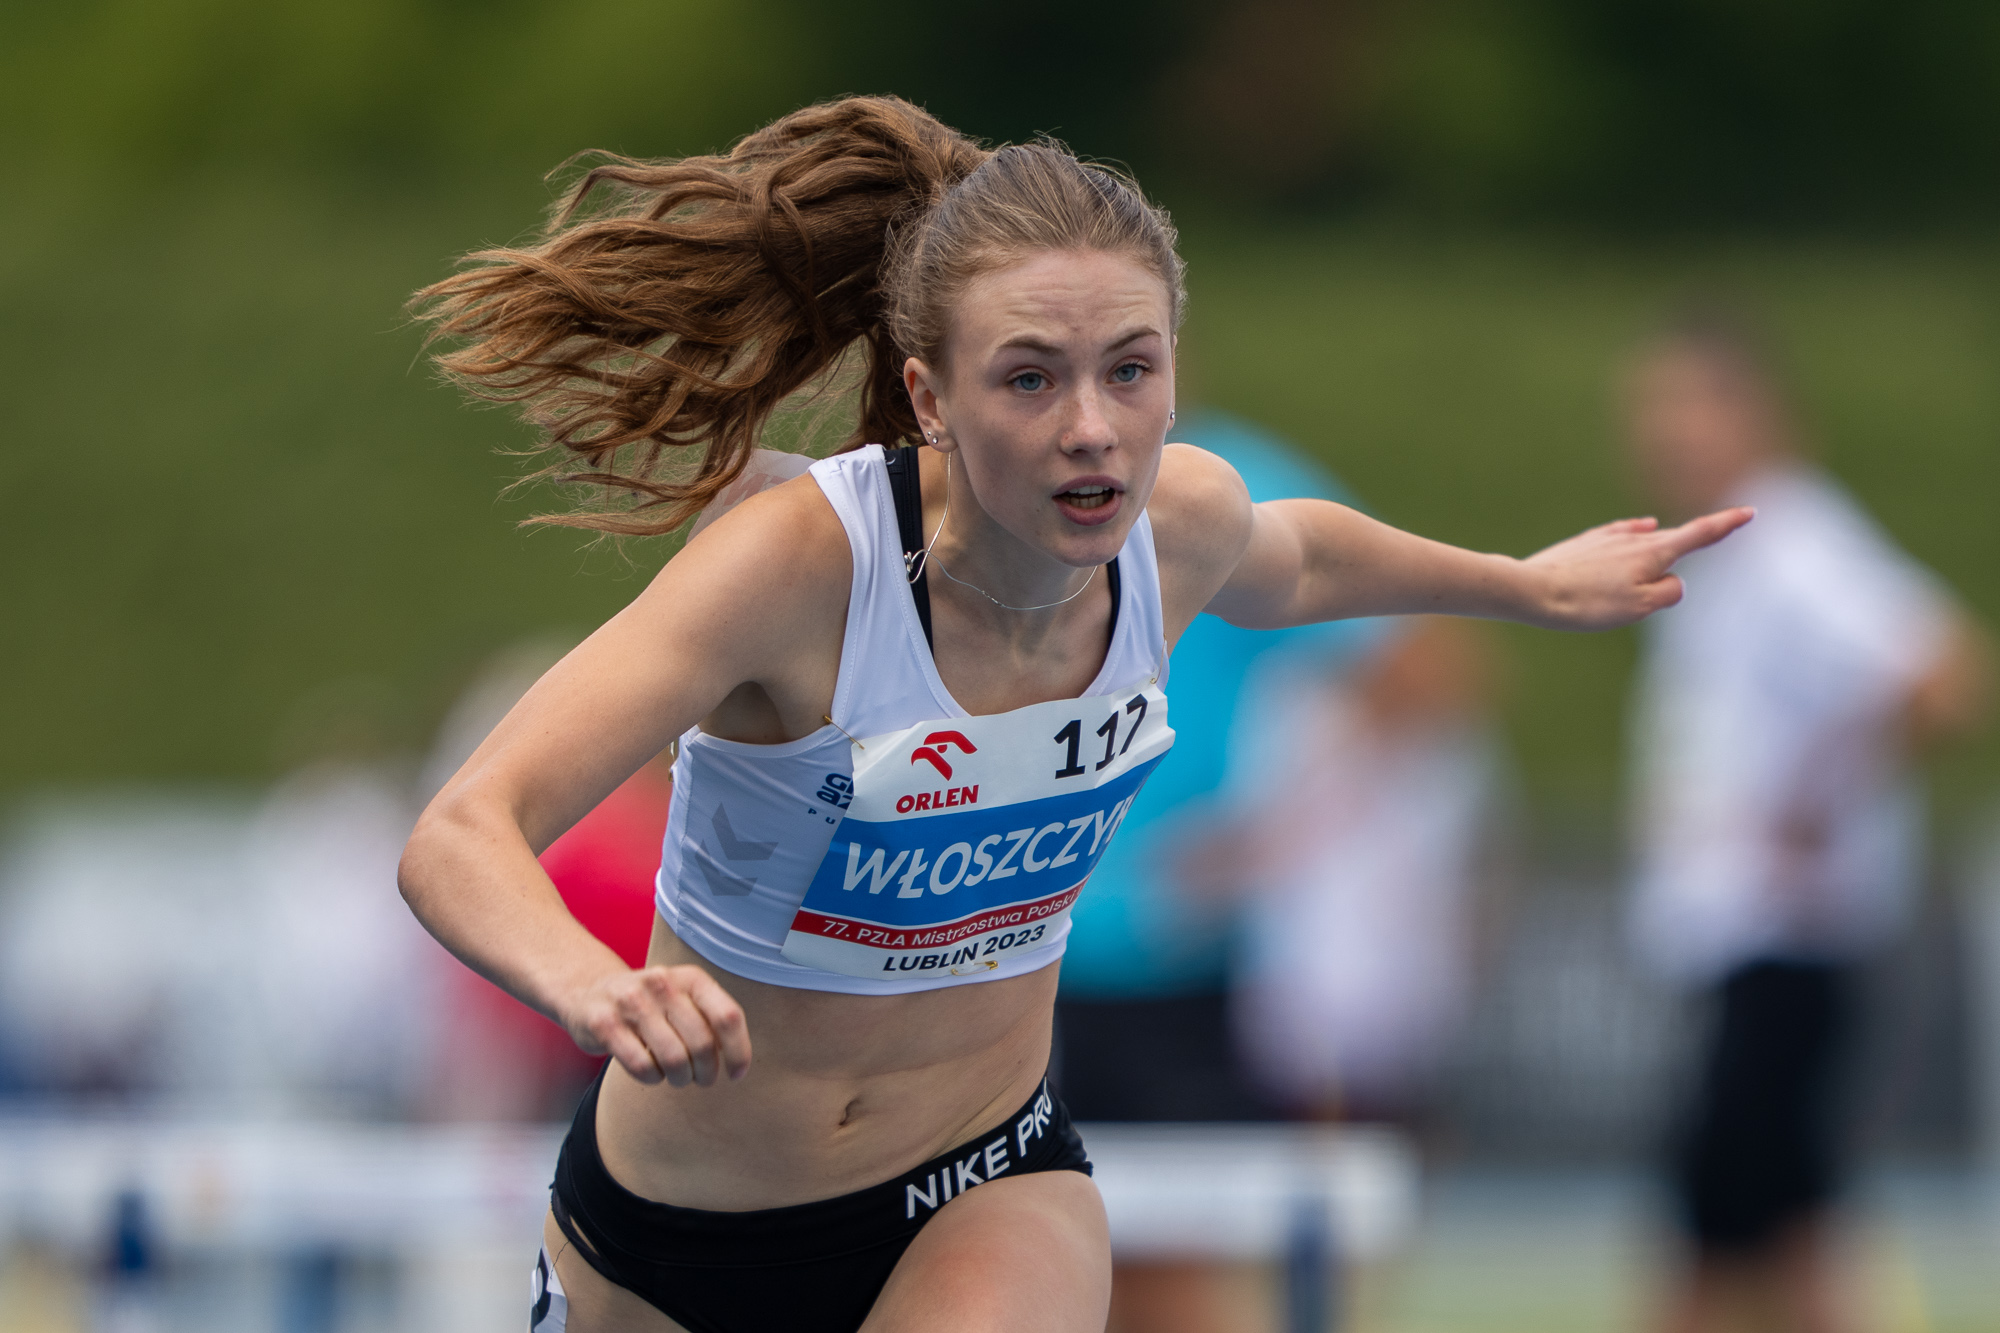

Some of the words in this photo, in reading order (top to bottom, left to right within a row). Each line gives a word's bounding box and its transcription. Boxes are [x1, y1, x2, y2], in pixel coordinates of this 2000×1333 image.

[1053, 693, 1148, 779] 117
[896, 785, 979, 814] ORLEN
[823, 920, 850, 938] 77.
[857, 928, 906, 947] PZLA
[911, 911, 1022, 946] Mistrzostwa
[1027, 890, 1077, 919] Polski
[883, 943, 979, 971] LUBLIN
[983, 924, 1046, 955] 2023
[906, 1135, 1011, 1219] NIKE
